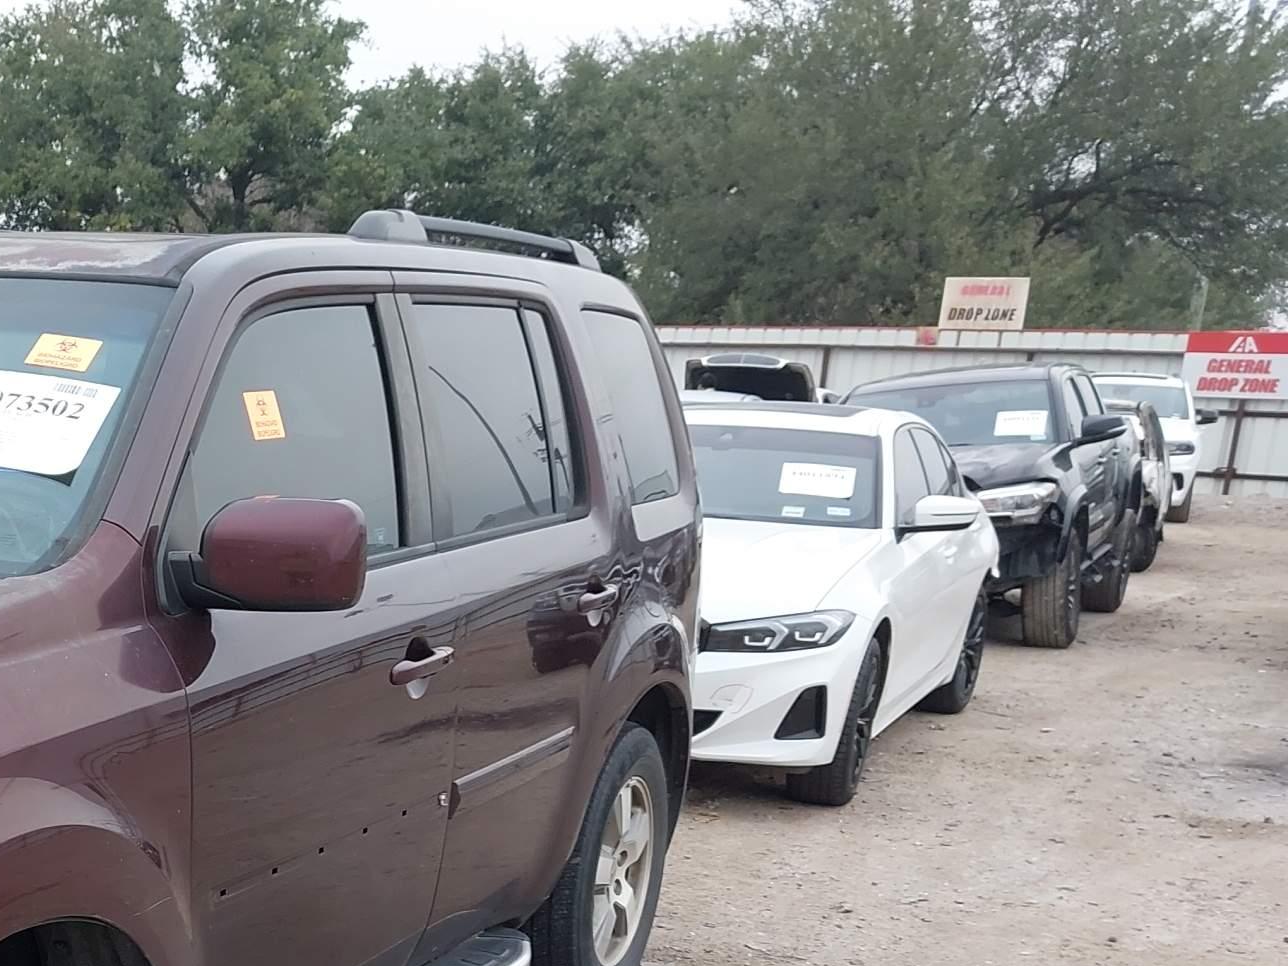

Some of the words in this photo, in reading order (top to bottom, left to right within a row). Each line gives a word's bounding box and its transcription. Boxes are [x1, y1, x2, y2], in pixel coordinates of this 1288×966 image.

[948, 307, 983, 321] DROP
[984, 308, 1016, 321] ZONE
[1207, 359, 1272, 374] GENERAL
[1196, 377, 1239, 392] DROP
[1239, 379, 1280, 393] ZONE
